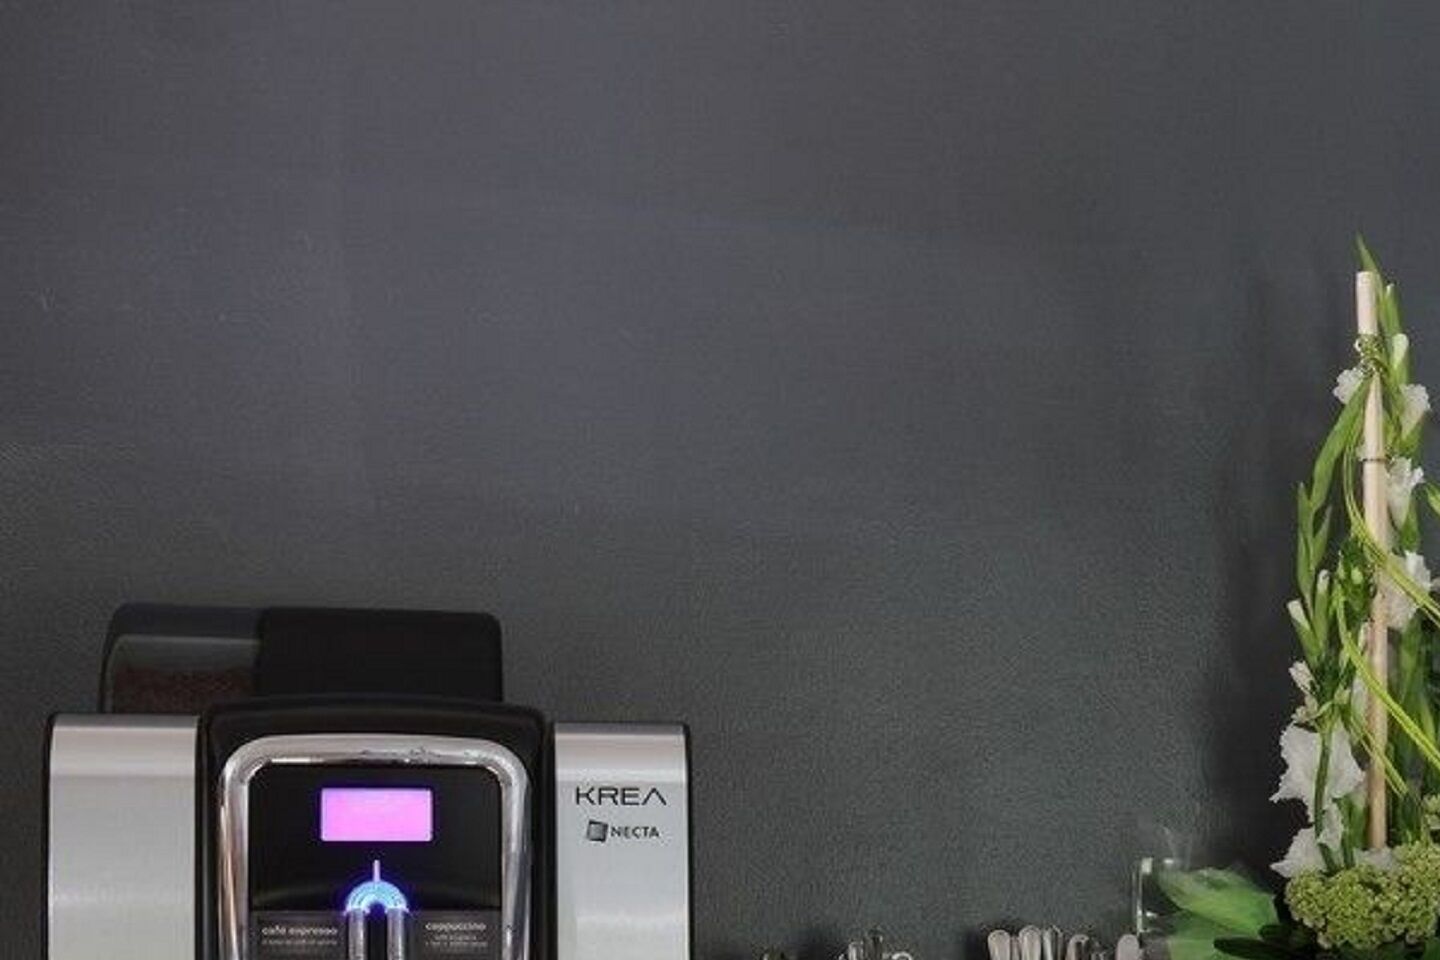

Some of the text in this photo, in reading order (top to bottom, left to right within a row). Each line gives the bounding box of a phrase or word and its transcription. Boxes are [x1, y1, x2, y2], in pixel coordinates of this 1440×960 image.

[576, 787, 666, 805] KREA
[611, 826, 659, 839] NECTA
[425, 922, 486, 932] cappuccino
